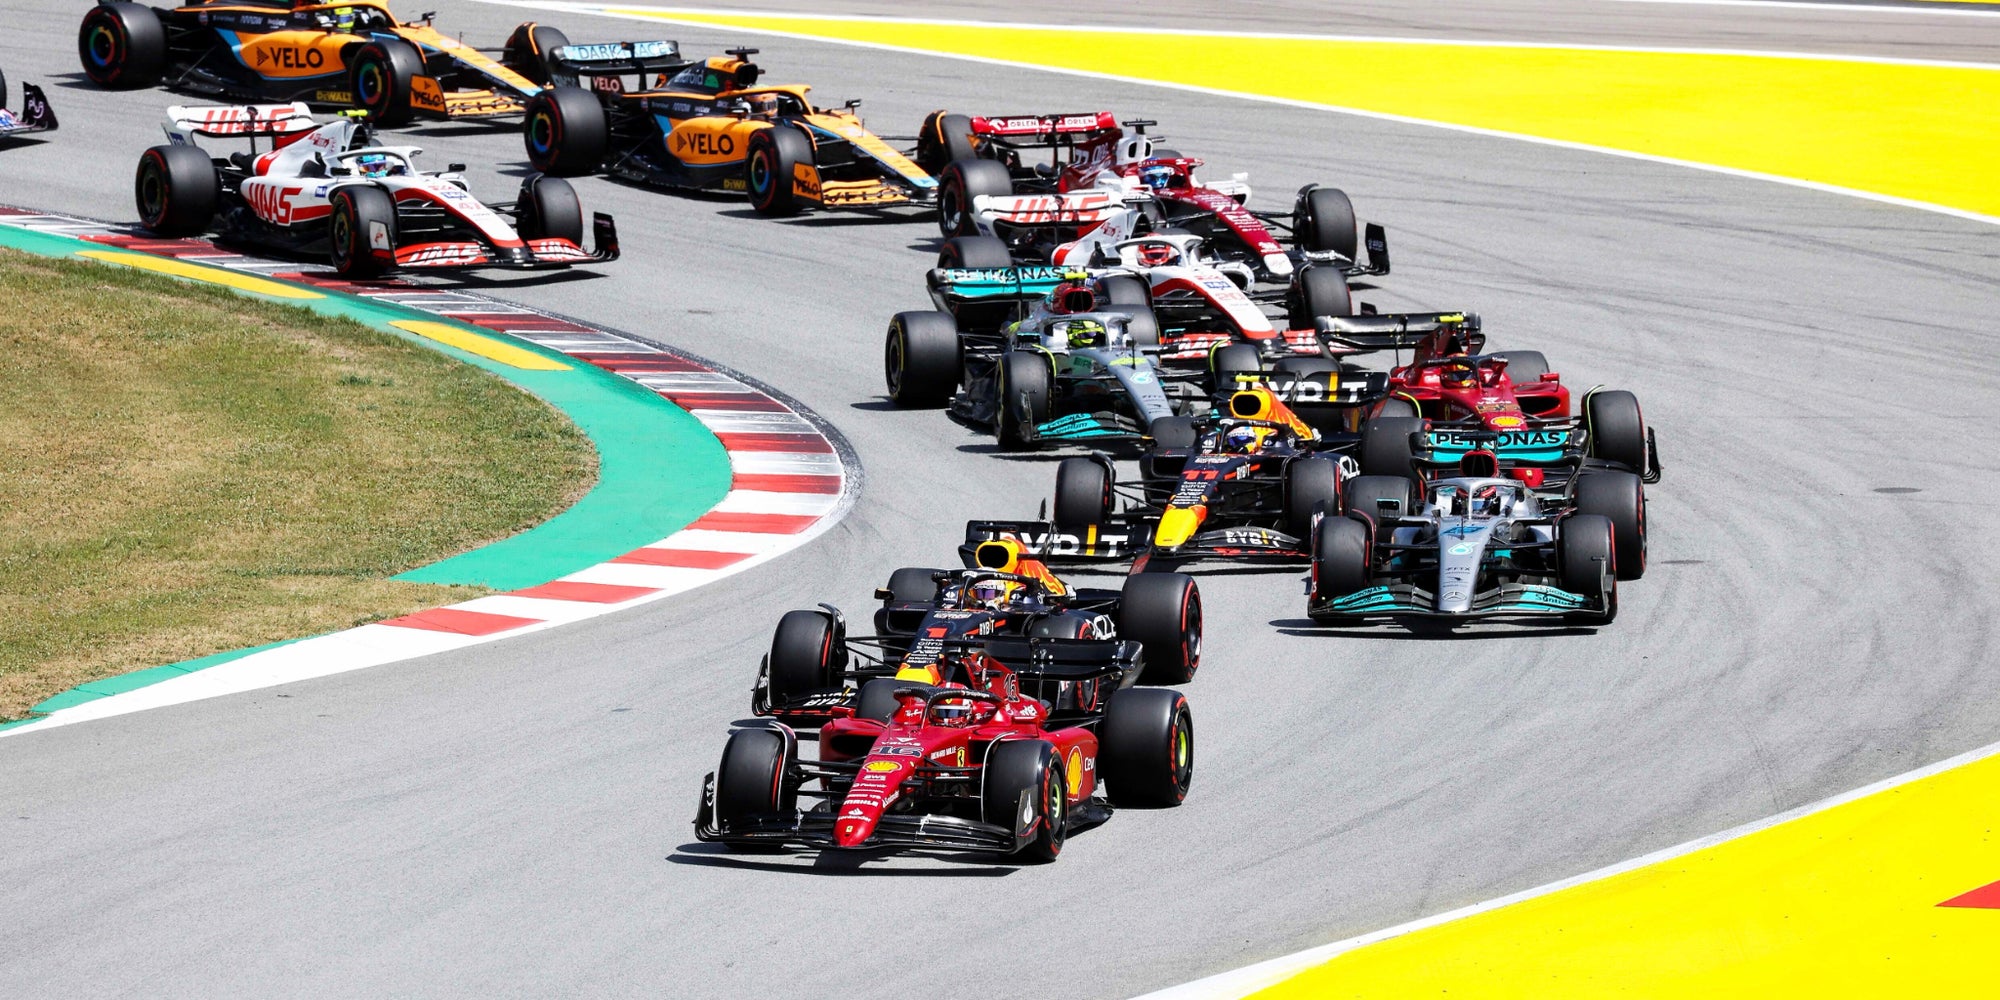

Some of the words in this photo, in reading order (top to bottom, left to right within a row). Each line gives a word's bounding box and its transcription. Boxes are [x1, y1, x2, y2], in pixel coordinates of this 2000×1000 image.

[270, 47, 324, 69] VELO
[593, 77, 620, 93] VELO
[412, 91, 442, 107] VELO
[1066, 117, 1096, 125] ORLEN
[687, 133, 735, 156] VELO
[250, 182, 303, 227] HAAS
[1183, 469, 1220, 480] 11
[1225, 529, 1281, 548] BYBIT
